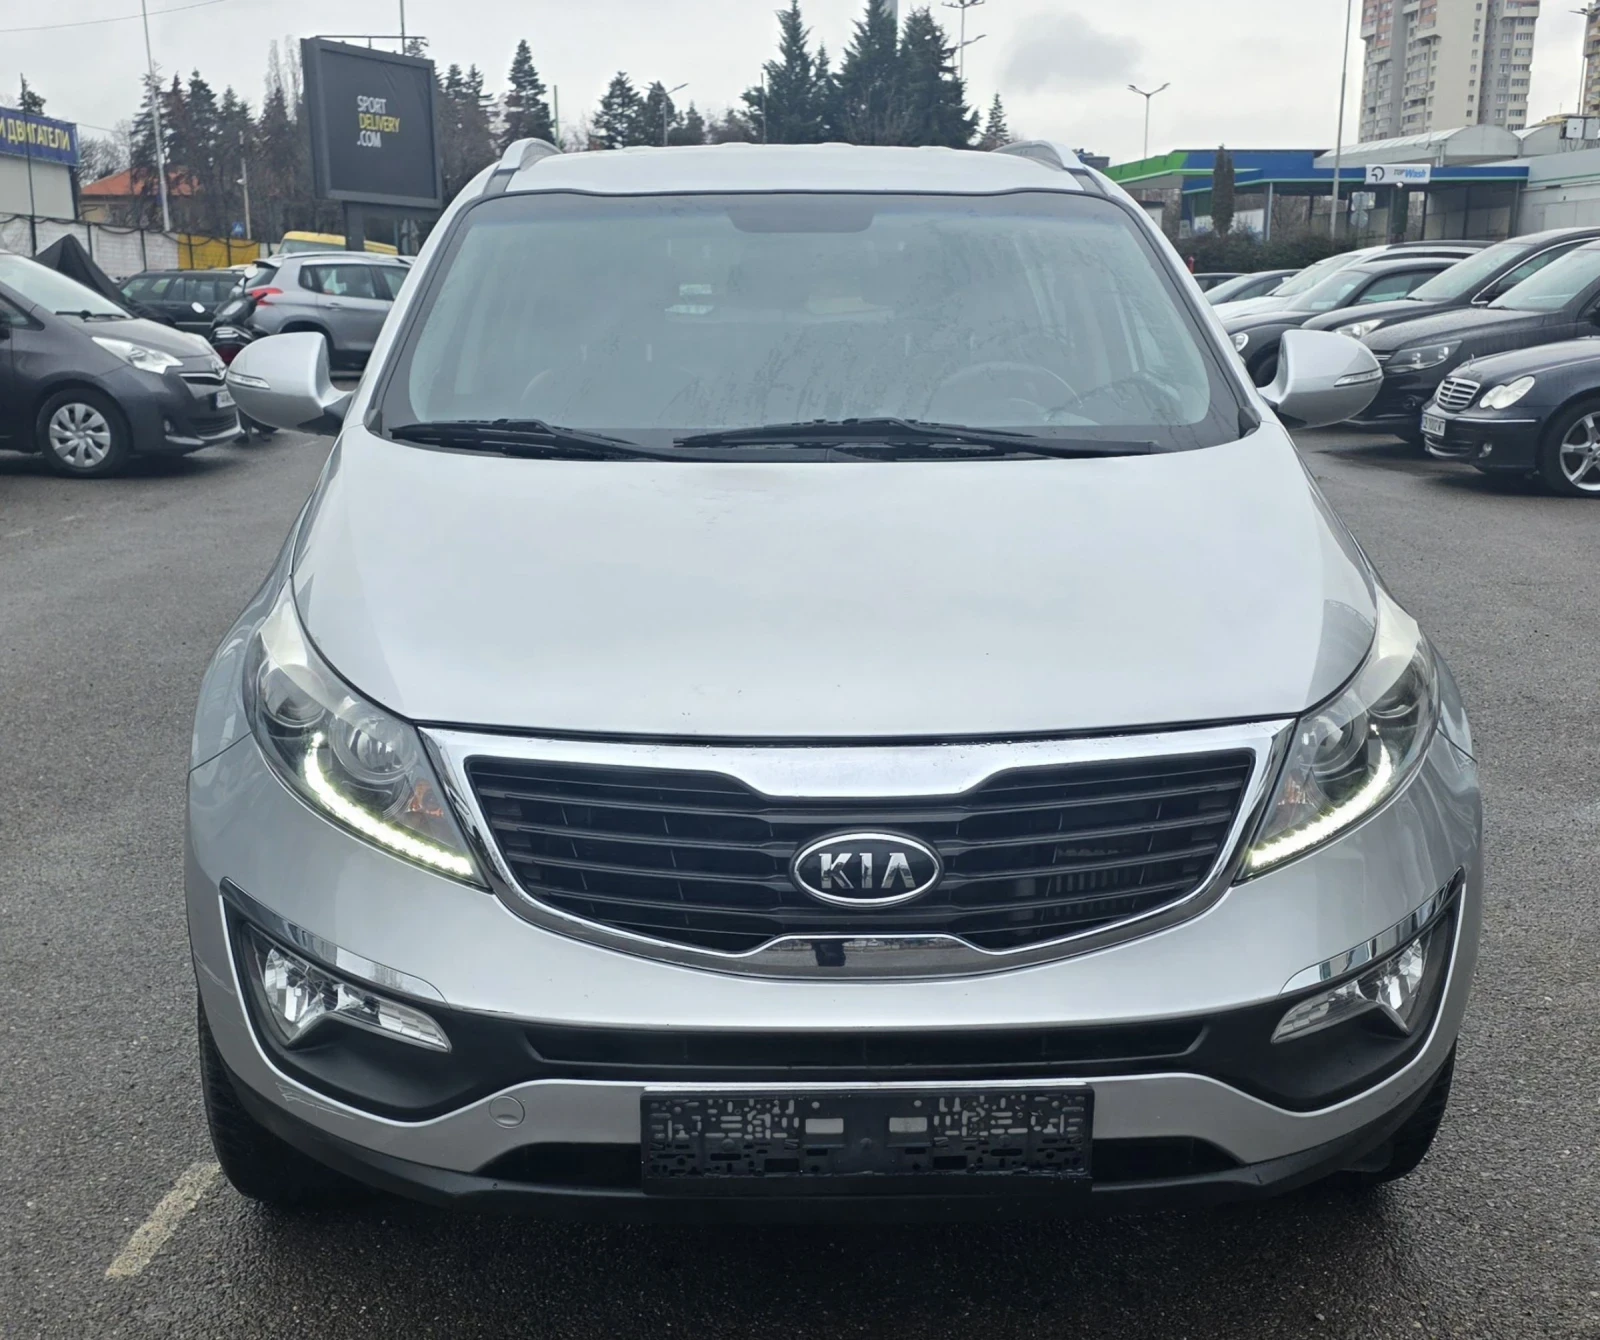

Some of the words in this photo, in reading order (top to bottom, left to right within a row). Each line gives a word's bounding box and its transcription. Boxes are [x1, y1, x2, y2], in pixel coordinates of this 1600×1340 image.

[357, 95, 387, 114] SPORT
[359, 113, 400, 133] DELIVERY
[8, 119, 71, 151] ДВИГАТЕЛИ
[356, 130, 382, 148] .COM
[819, 853, 916, 889] KIA
